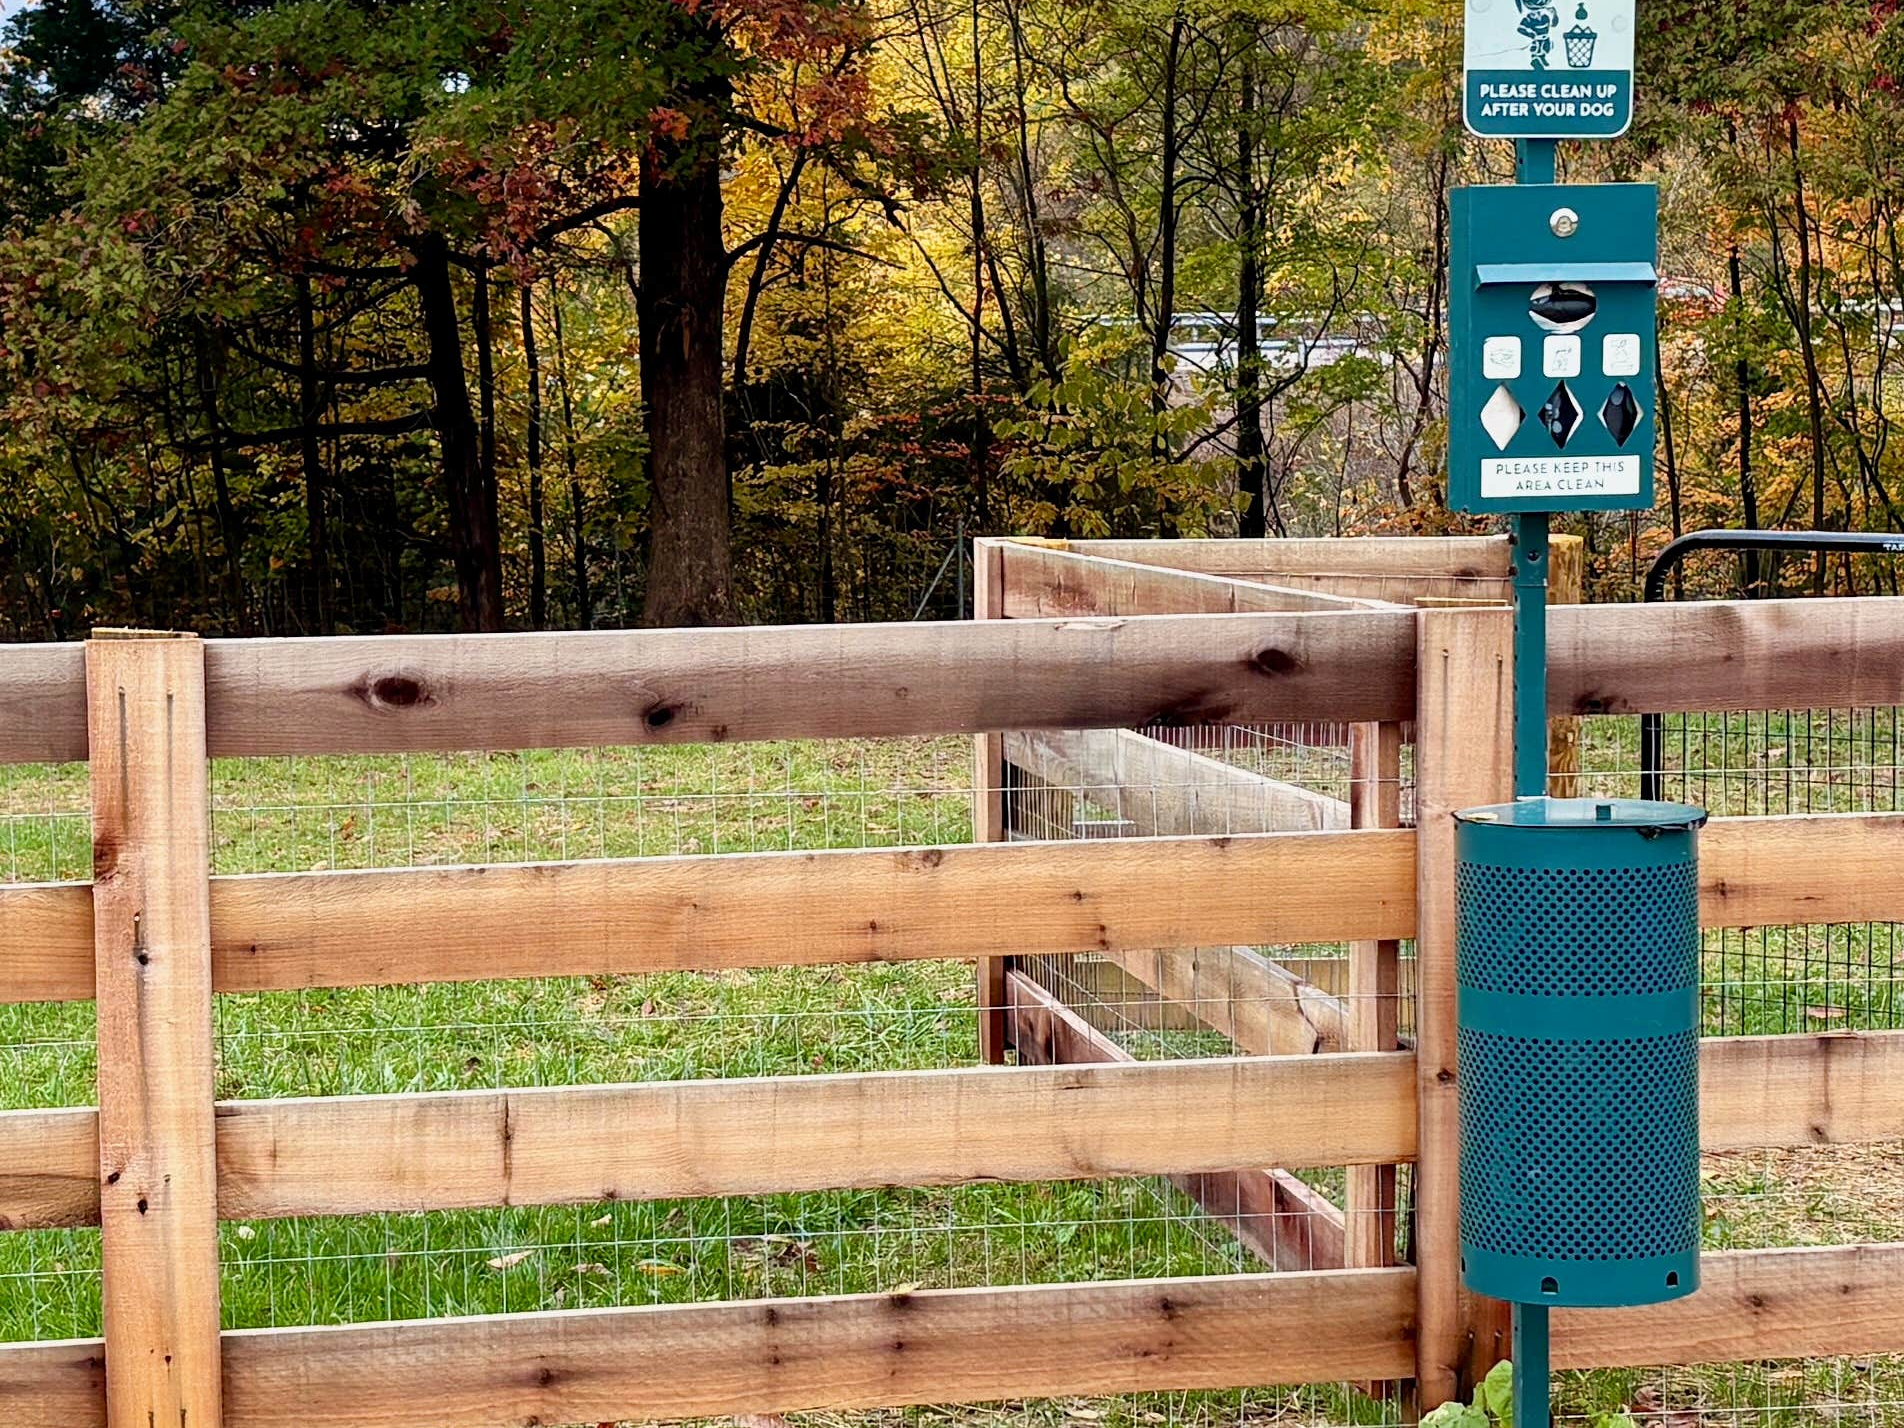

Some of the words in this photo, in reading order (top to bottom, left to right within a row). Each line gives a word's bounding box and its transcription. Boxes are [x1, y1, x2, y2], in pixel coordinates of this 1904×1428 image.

[1480, 84, 1537, 98] PLEASE
[1541, 84, 1592, 98] CLEAN
[1596, 84, 1617, 98] UP
[1481, 103, 1529, 117] AFTER
[1533, 103, 1576, 117] YOUR
[1580, 103, 1614, 117] DOG
[1495, 463, 1548, 475] PLEASE
[1553, 462, 1589, 474] KEEP
[1595, 461, 1624, 472] THIS
[1516, 480, 1551, 491] AREA
[1557, 479, 1604, 490] CLEAN
